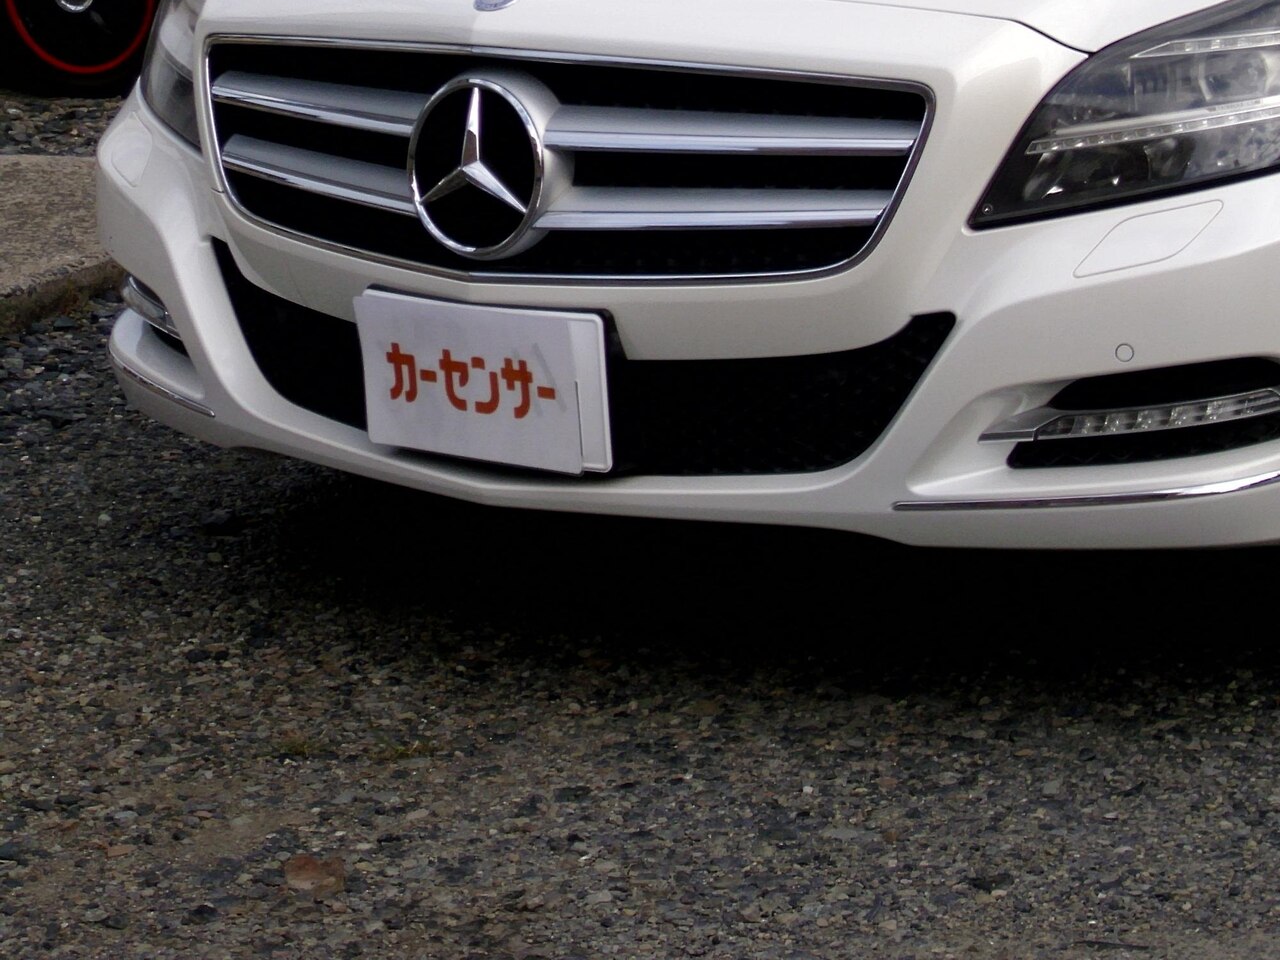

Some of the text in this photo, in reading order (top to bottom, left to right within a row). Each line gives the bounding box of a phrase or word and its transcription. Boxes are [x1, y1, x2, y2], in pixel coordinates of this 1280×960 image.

[386, 342, 556, 419] カーセンサー
